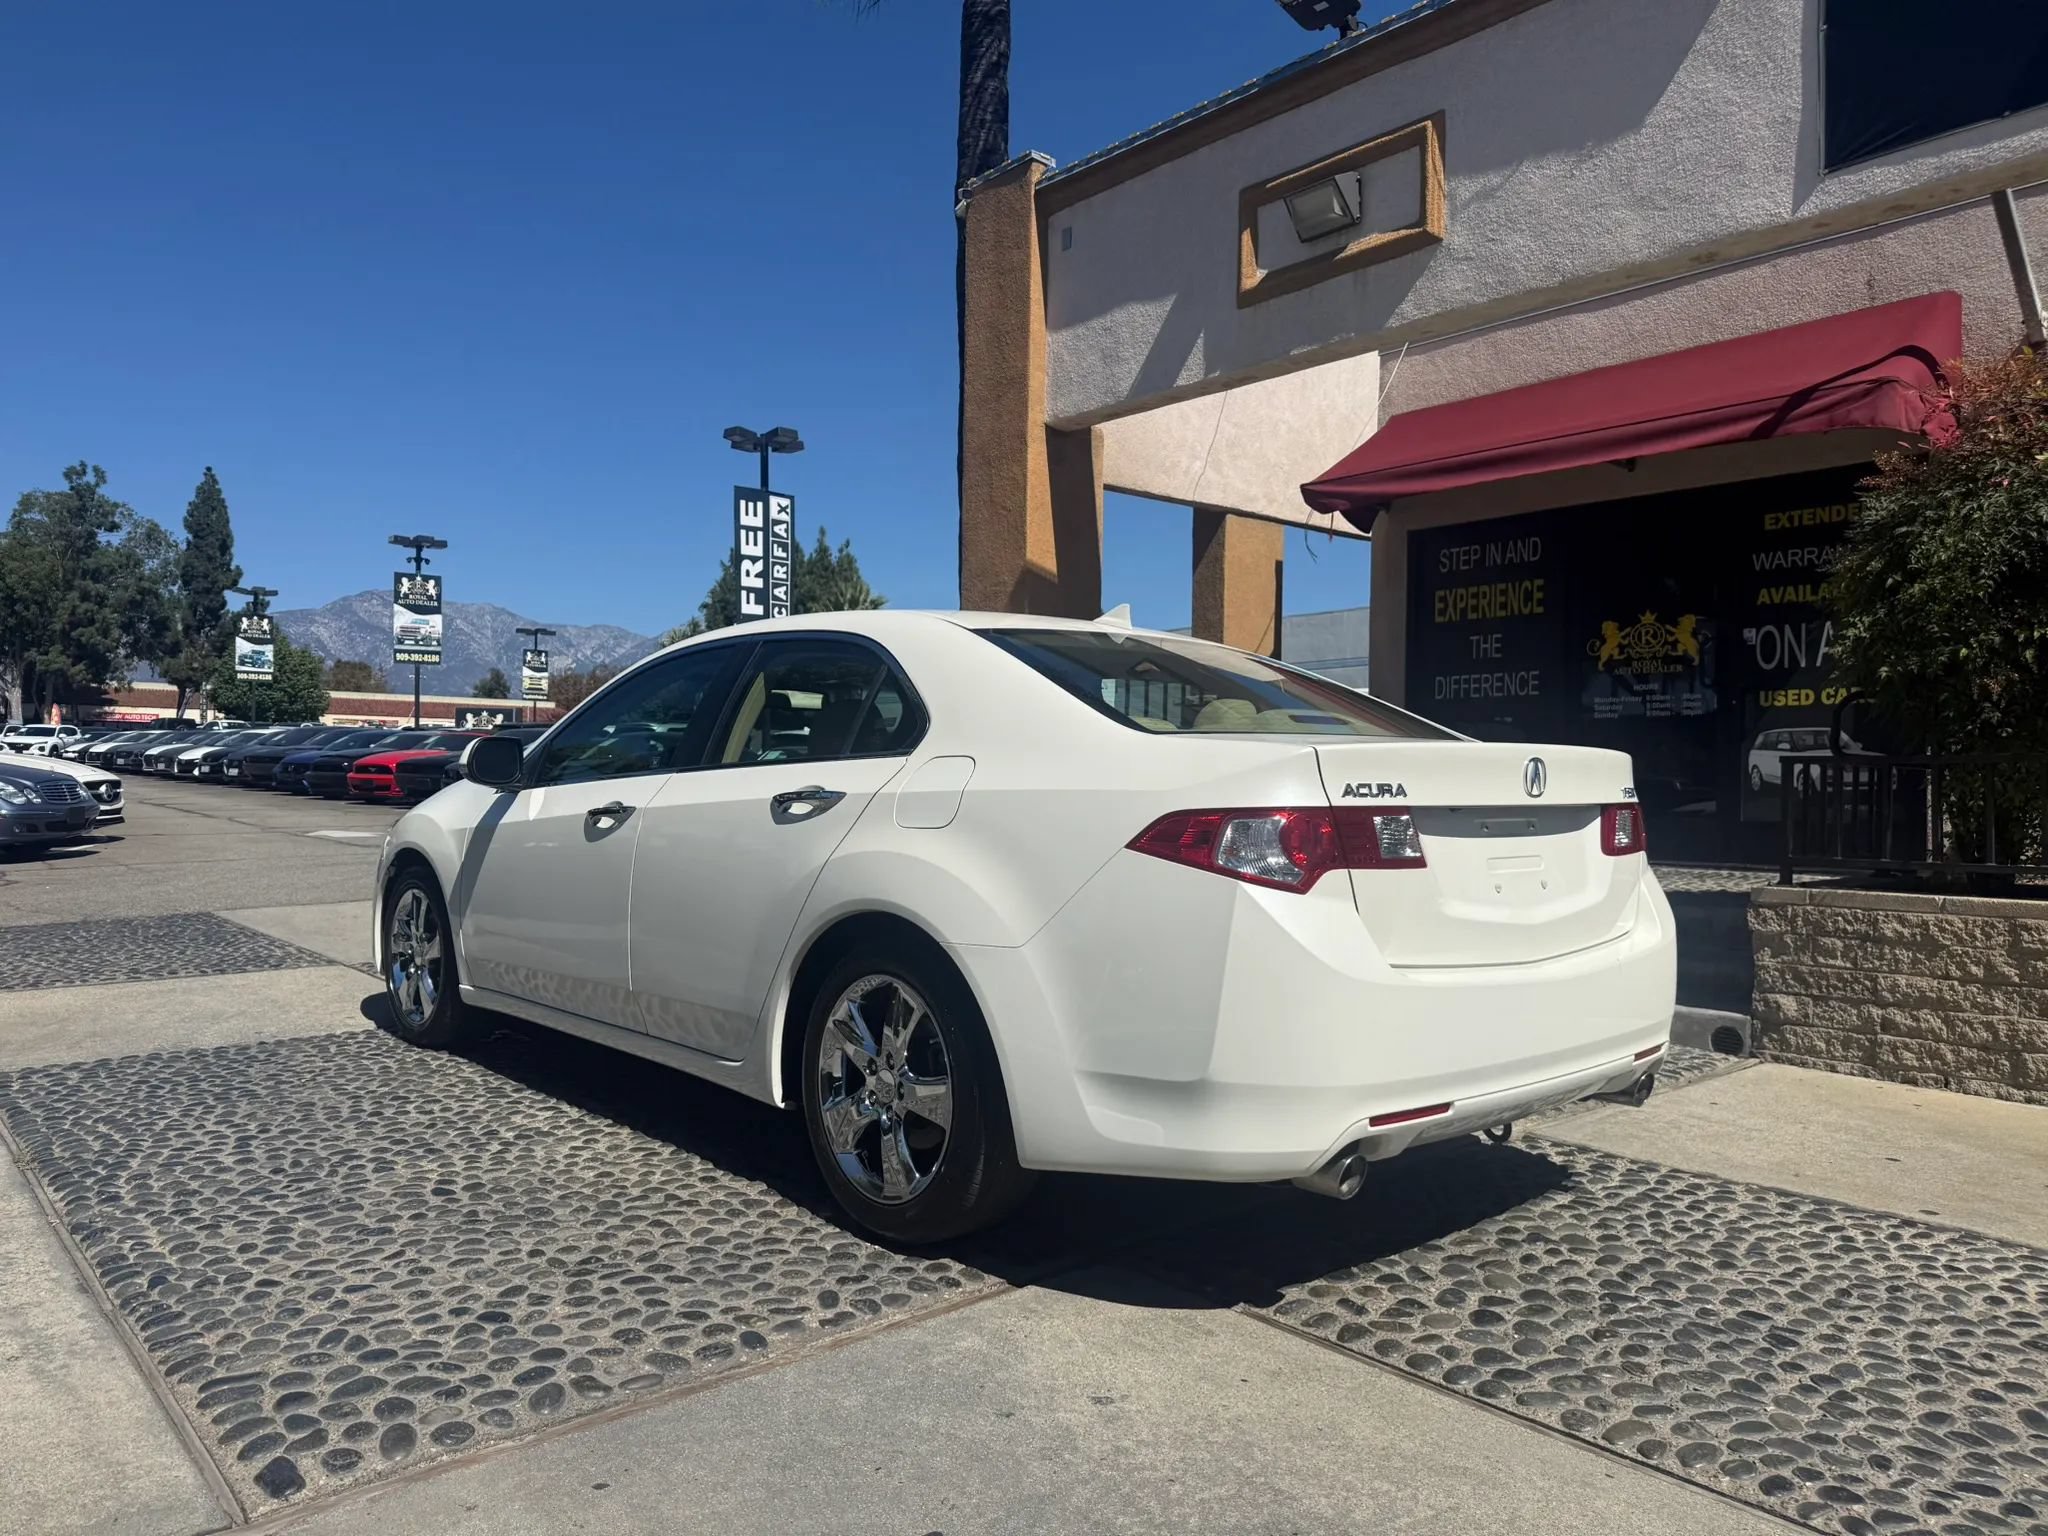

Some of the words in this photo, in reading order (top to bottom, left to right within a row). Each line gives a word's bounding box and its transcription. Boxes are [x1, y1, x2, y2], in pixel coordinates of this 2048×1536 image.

[1764, 502, 1866, 530] EXTENDE
[740, 500, 763, 615] FREE
[773, 501, 789, 618] CARFAX
[1439, 544, 1481, 573] STEP
[1485, 542, 1501, 567] IN
[1504, 537, 1542, 565] AND
[1752, 546, 1848, 571] WARRA
[1434, 578, 1545, 623] EXPERIENCE
[1757, 581, 1842, 605] AVAILA
[1469, 634, 1502, 659] THE
[1756, 623, 1806, 670] ON
[1642, 664, 1683, 674] DEALER
[1434, 670, 1540, 700] DIFFERENCE
[1759, 688, 1815, 707] USED
[1341, 782, 1408, 798] ACURA
